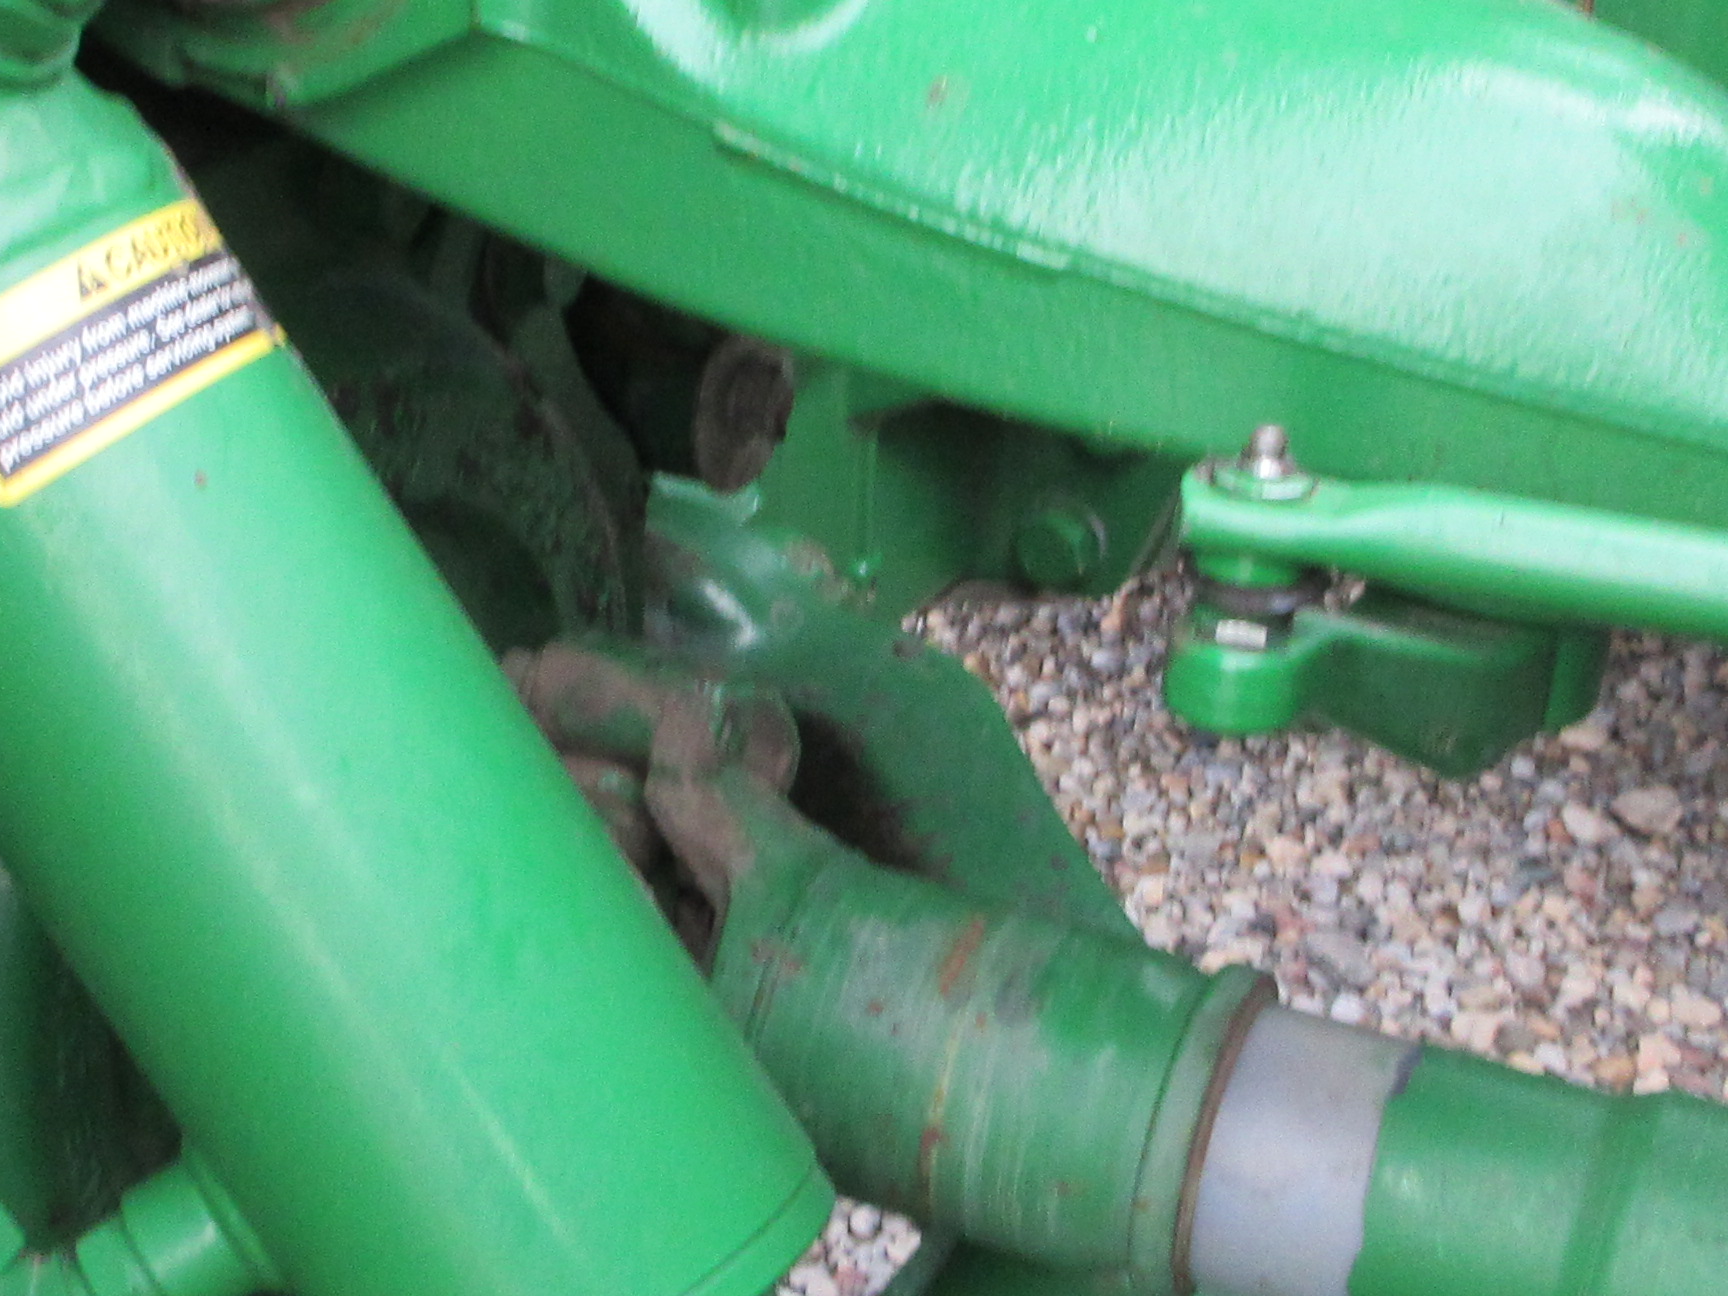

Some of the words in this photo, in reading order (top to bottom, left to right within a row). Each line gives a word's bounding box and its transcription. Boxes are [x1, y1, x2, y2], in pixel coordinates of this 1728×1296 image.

[24, 336, 82, 390] injury
[82, 312, 127, 354] from
[25, 372, 77, 421] under
[84, 362, 145, 416] before
